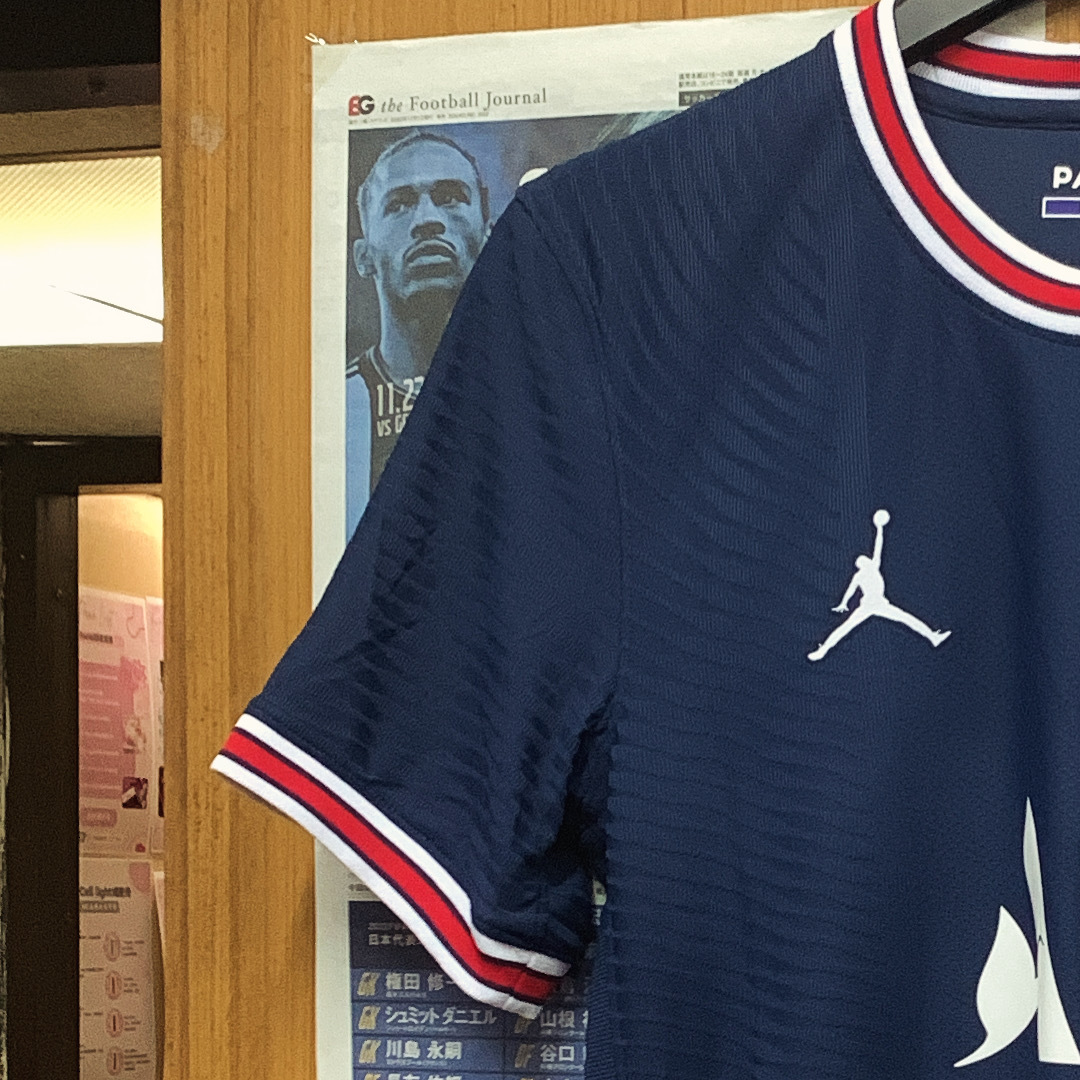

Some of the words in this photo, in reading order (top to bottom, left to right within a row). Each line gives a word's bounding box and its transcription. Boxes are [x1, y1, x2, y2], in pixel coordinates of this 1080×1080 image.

[381, 98, 403, 113] the
[410, 92, 479, 111] Football
[483, 88, 547, 112] Journal
[377, 419, 392, 437] VS
[540, 1045, 575, 1063] 谷口
